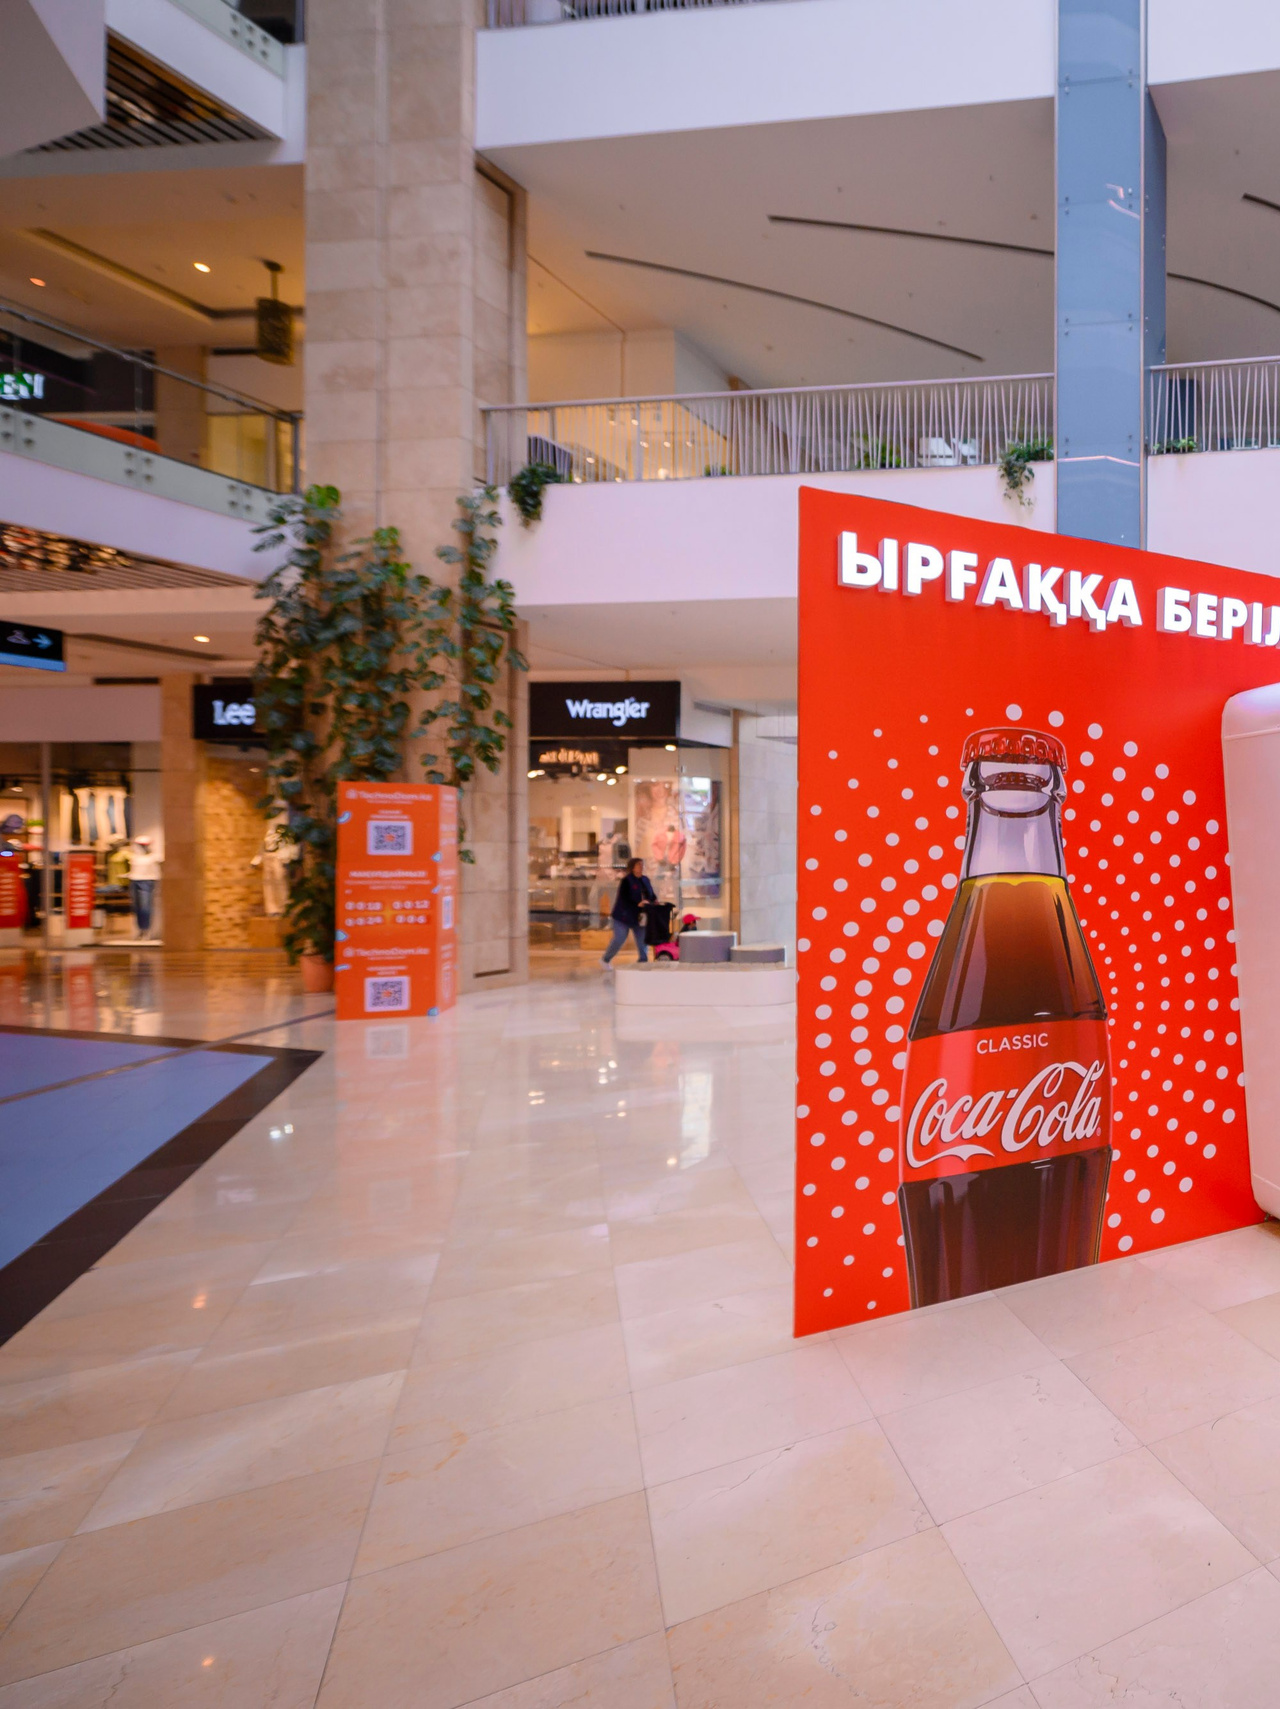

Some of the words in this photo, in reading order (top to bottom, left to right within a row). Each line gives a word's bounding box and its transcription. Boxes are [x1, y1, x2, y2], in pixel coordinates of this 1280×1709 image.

[838, 531, 1142, 632] ЫРҒАҚҚА
[212, 699, 256, 726] Lee
[565, 697, 651, 727] Wrangler
[976, 1033, 1049, 1055] CLASSIC
[906, 1059, 1106, 1169] Coca-Cola
